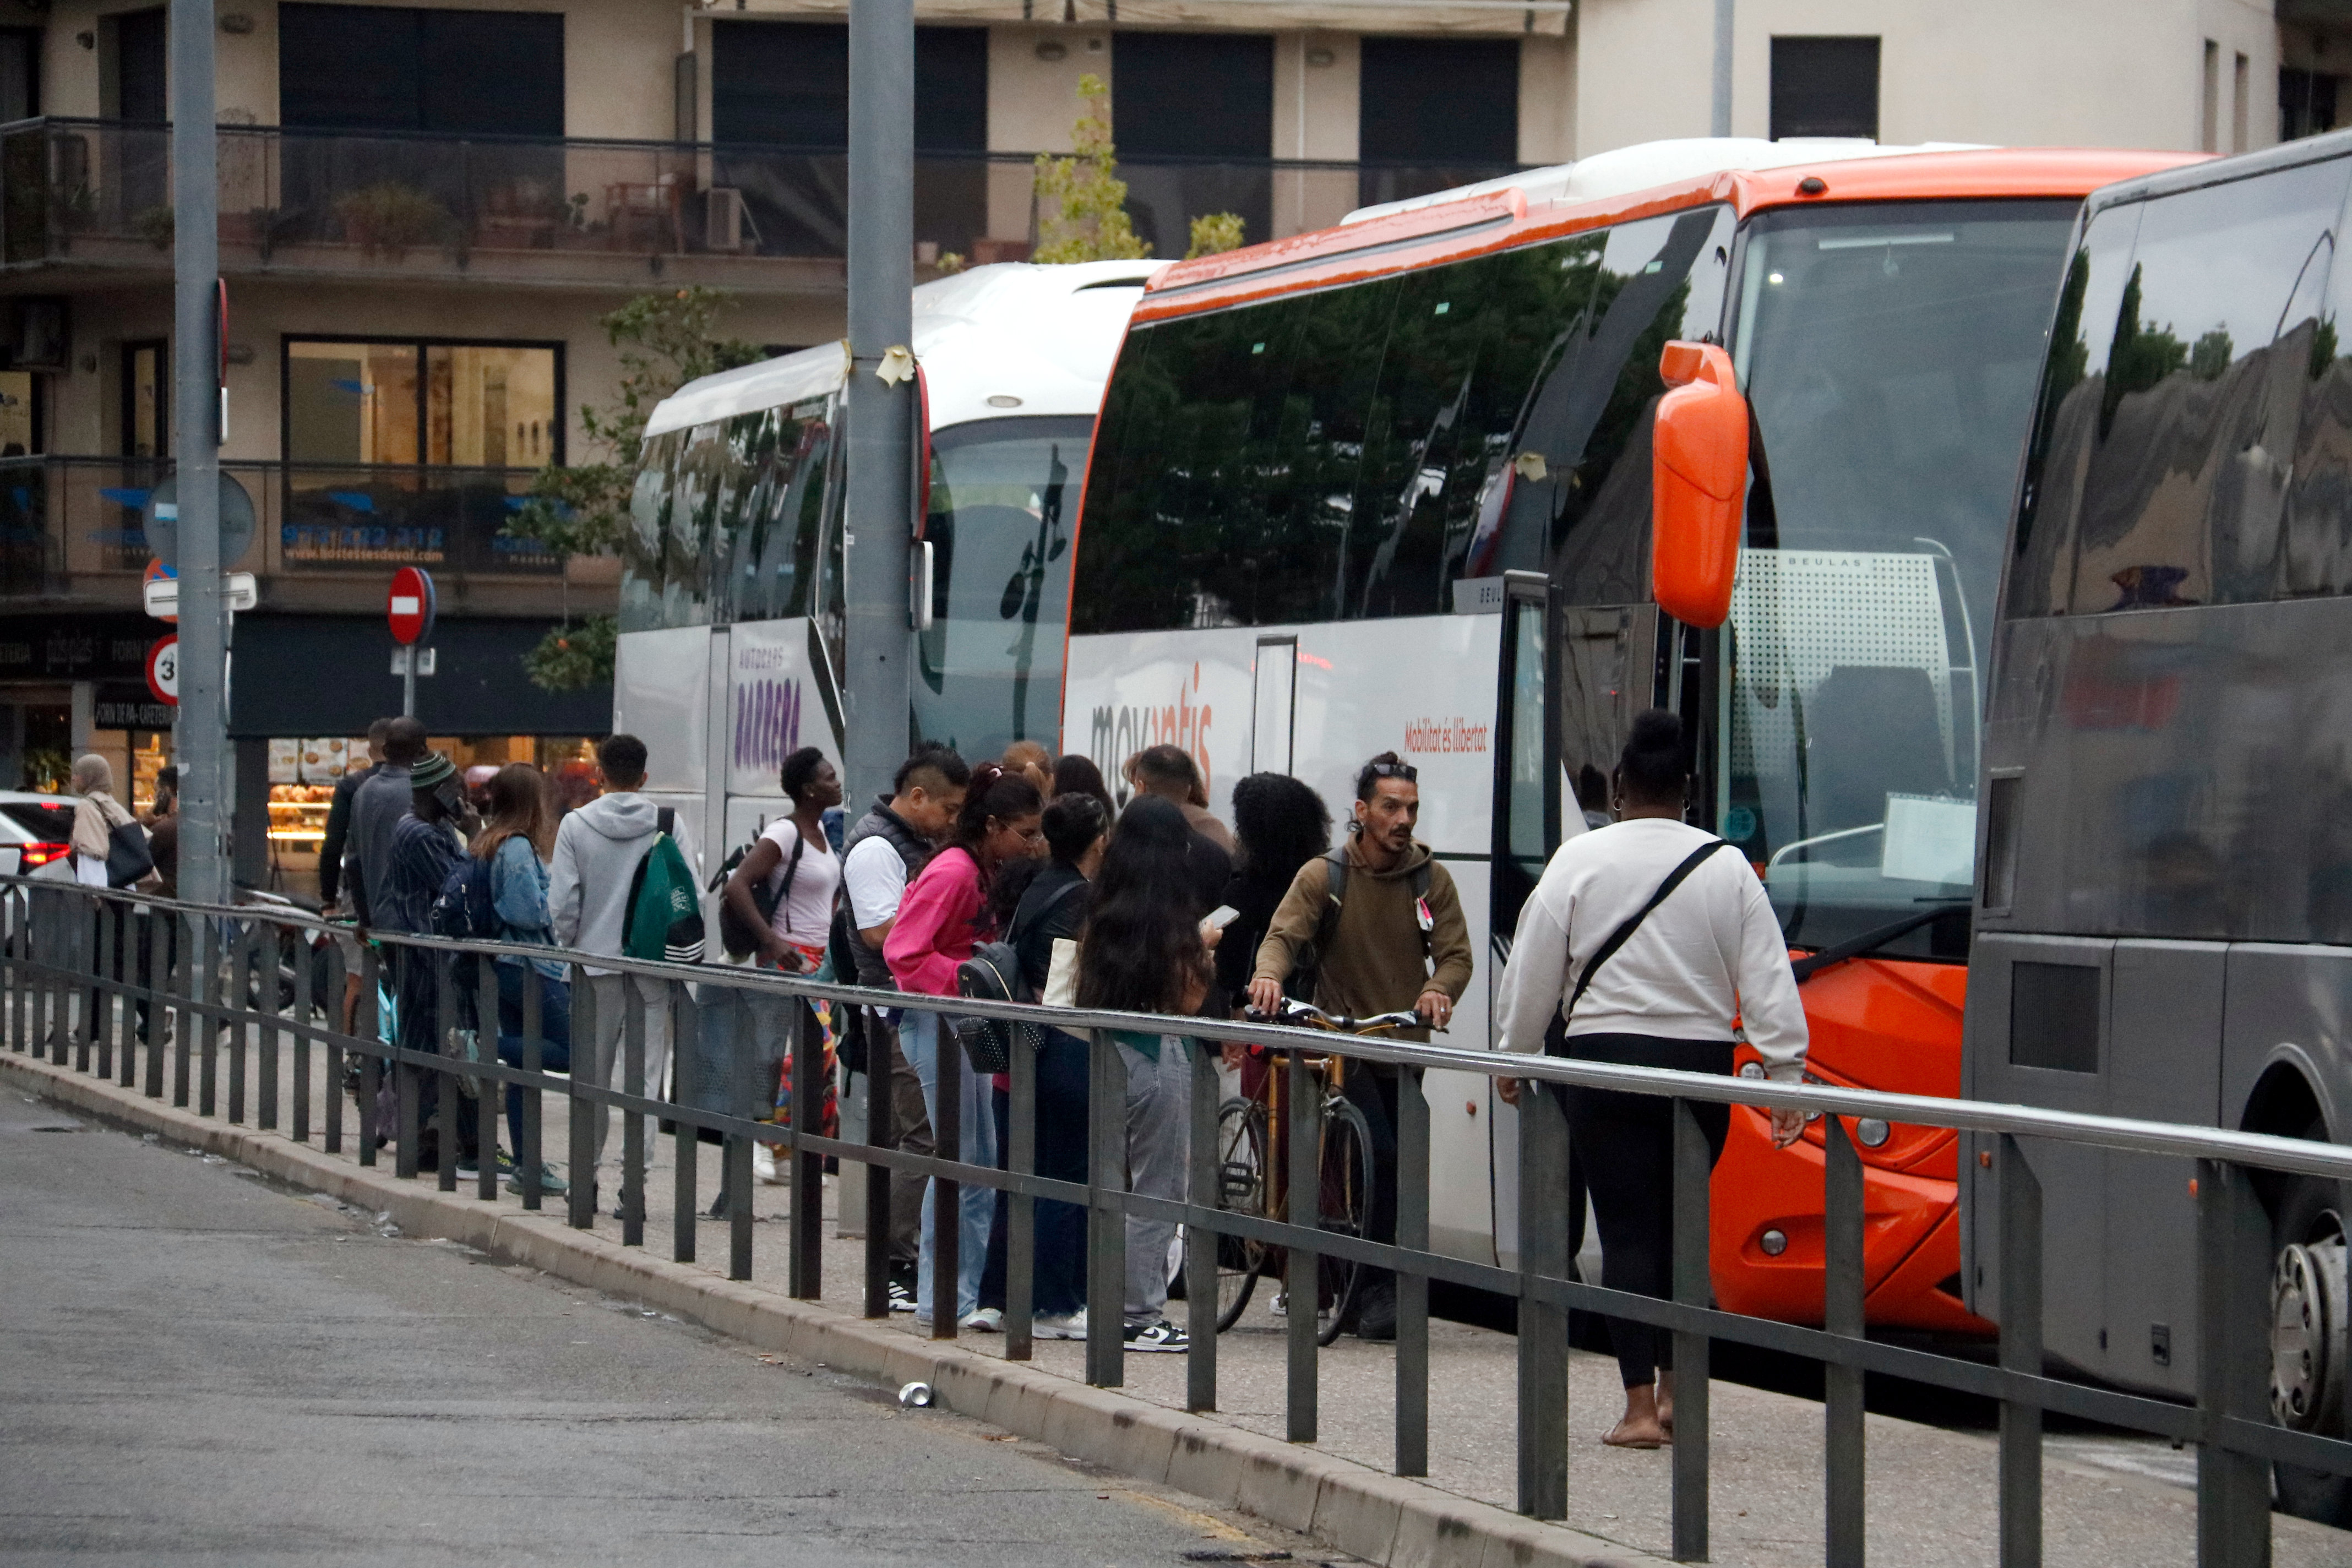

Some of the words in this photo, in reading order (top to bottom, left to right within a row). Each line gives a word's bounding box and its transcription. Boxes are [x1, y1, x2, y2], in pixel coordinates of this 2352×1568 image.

[1789, 558, 1860, 567] BEULAS
[1404, 717, 1441, 753] Mobilitat
[1442, 717, 1452, 753] és
[1453, 717, 1487, 753] llibertat
